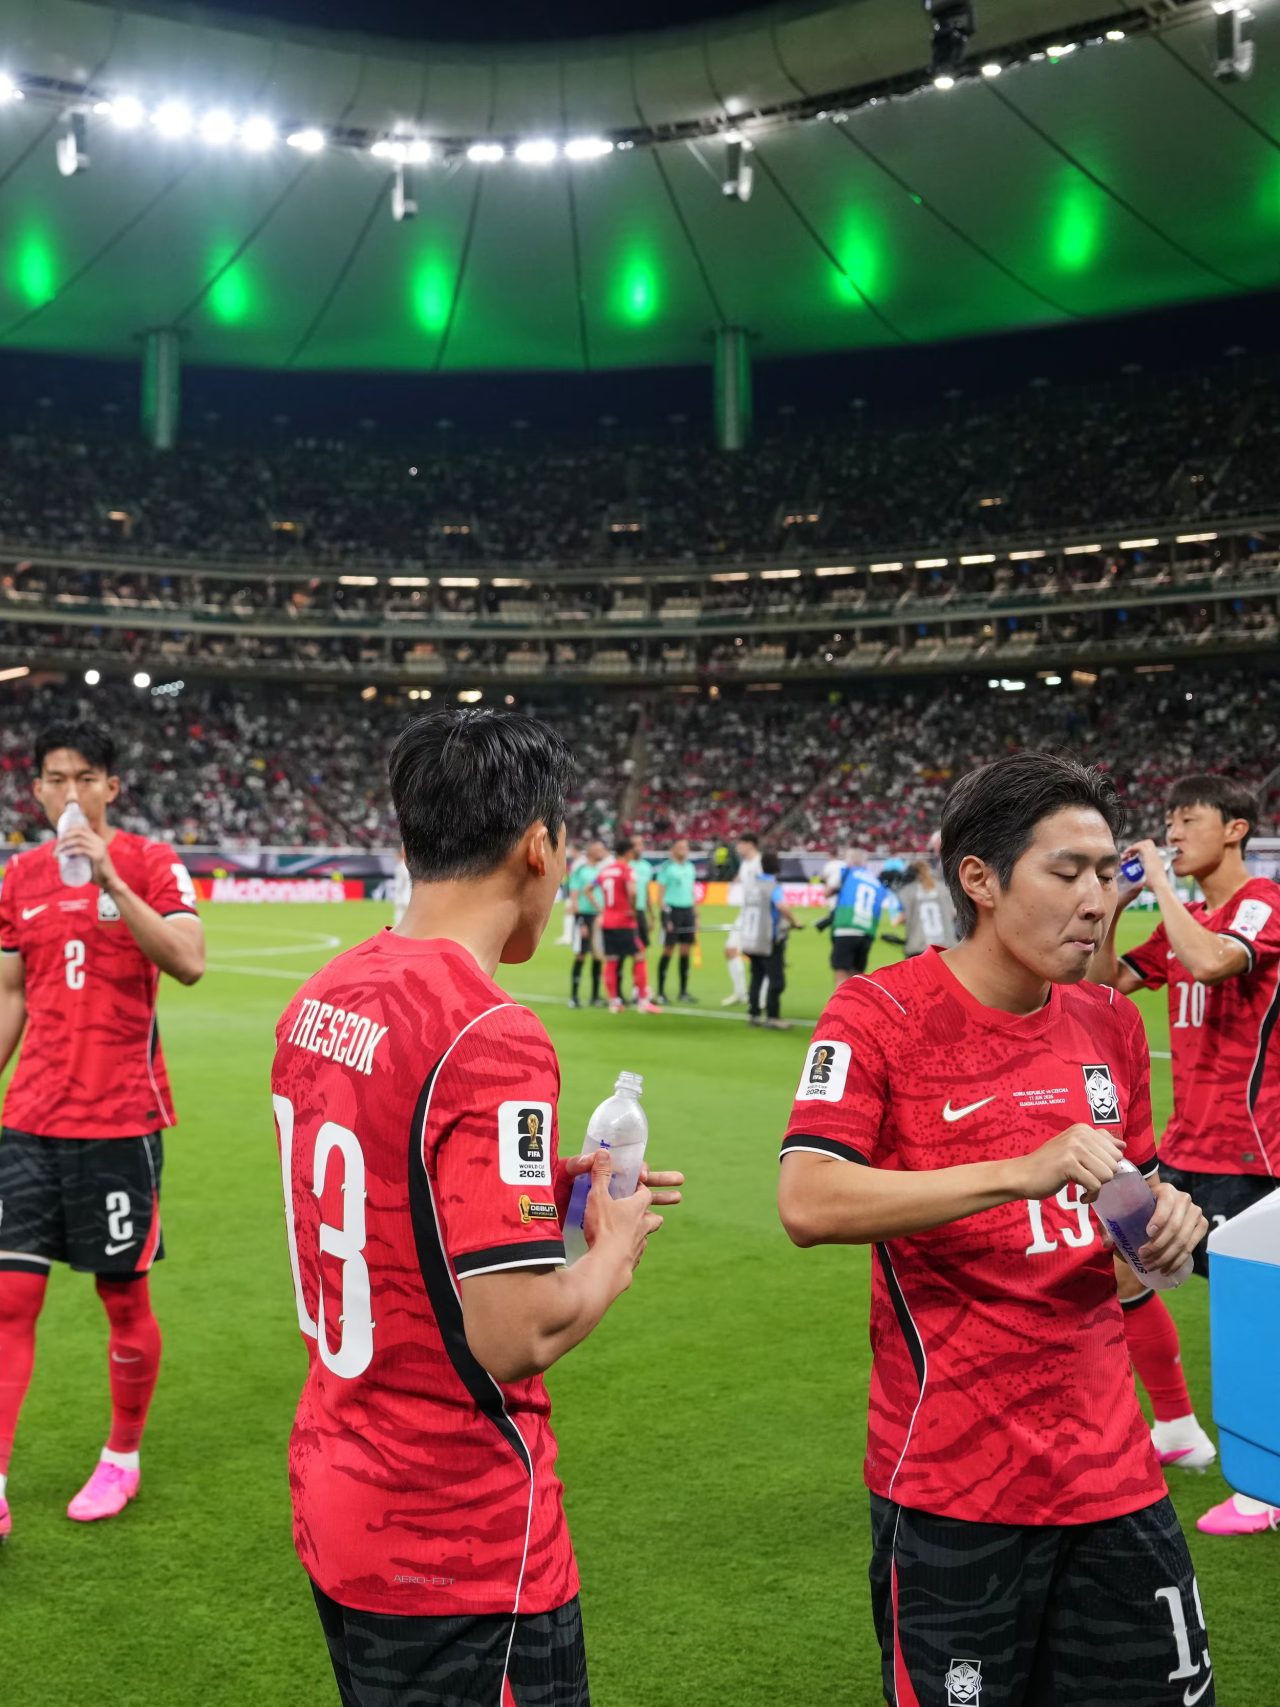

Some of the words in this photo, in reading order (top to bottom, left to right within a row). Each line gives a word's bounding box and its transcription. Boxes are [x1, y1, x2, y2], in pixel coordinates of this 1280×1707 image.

[64, 939, 85, 990] 2
[1173, 981, 1206, 1028] 10
[519, 1170, 546, 1178] 2026
[527, 1150, 541, 1158] FIFA
[106, 1190, 133, 1240] 2
[272, 1093, 375, 1379] 13
[1026, 1184, 1095, 1258] 19
[393, 1574, 455, 1585] AERO-FIT
